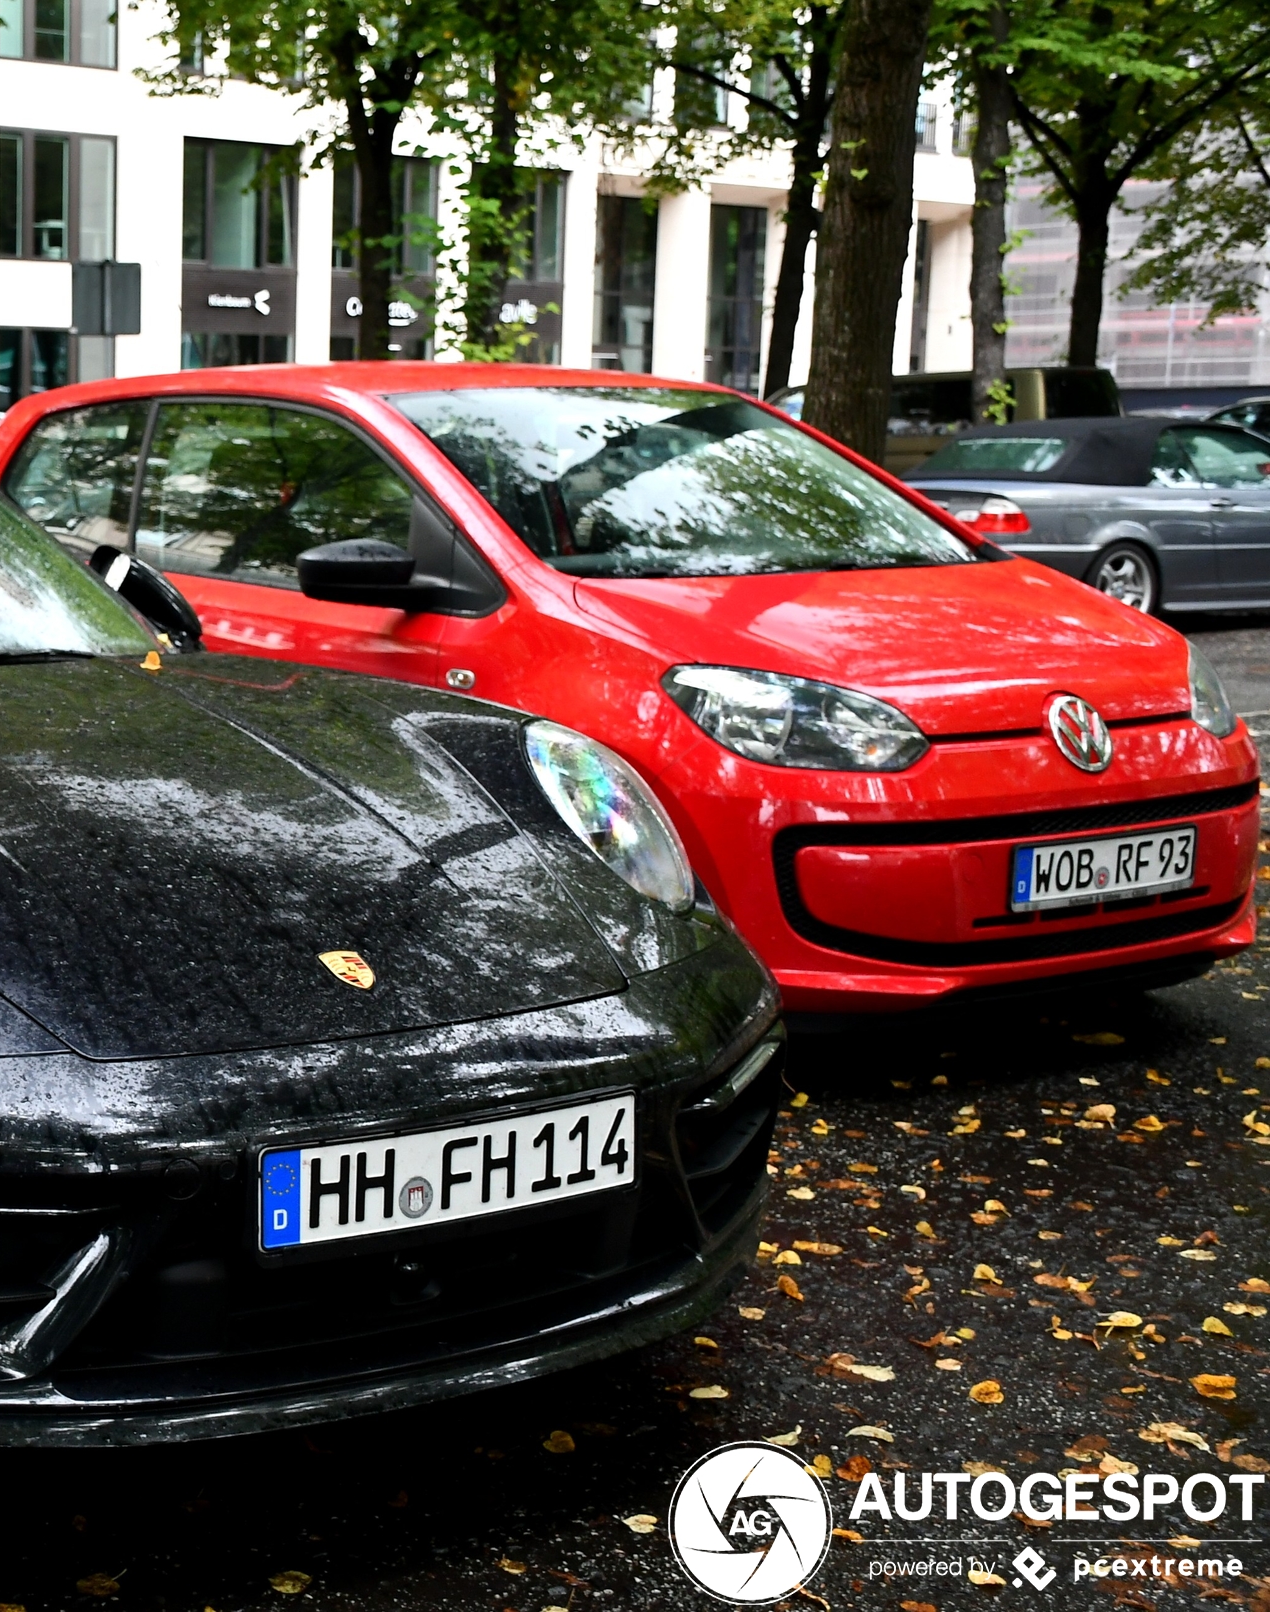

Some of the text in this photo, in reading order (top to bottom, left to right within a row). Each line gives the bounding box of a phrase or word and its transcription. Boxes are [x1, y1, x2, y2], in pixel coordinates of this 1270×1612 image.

[1035, 849, 1095, 894] WOB
[308, 1147, 396, 1229] HH
[273, 1207, 289, 1231] D
